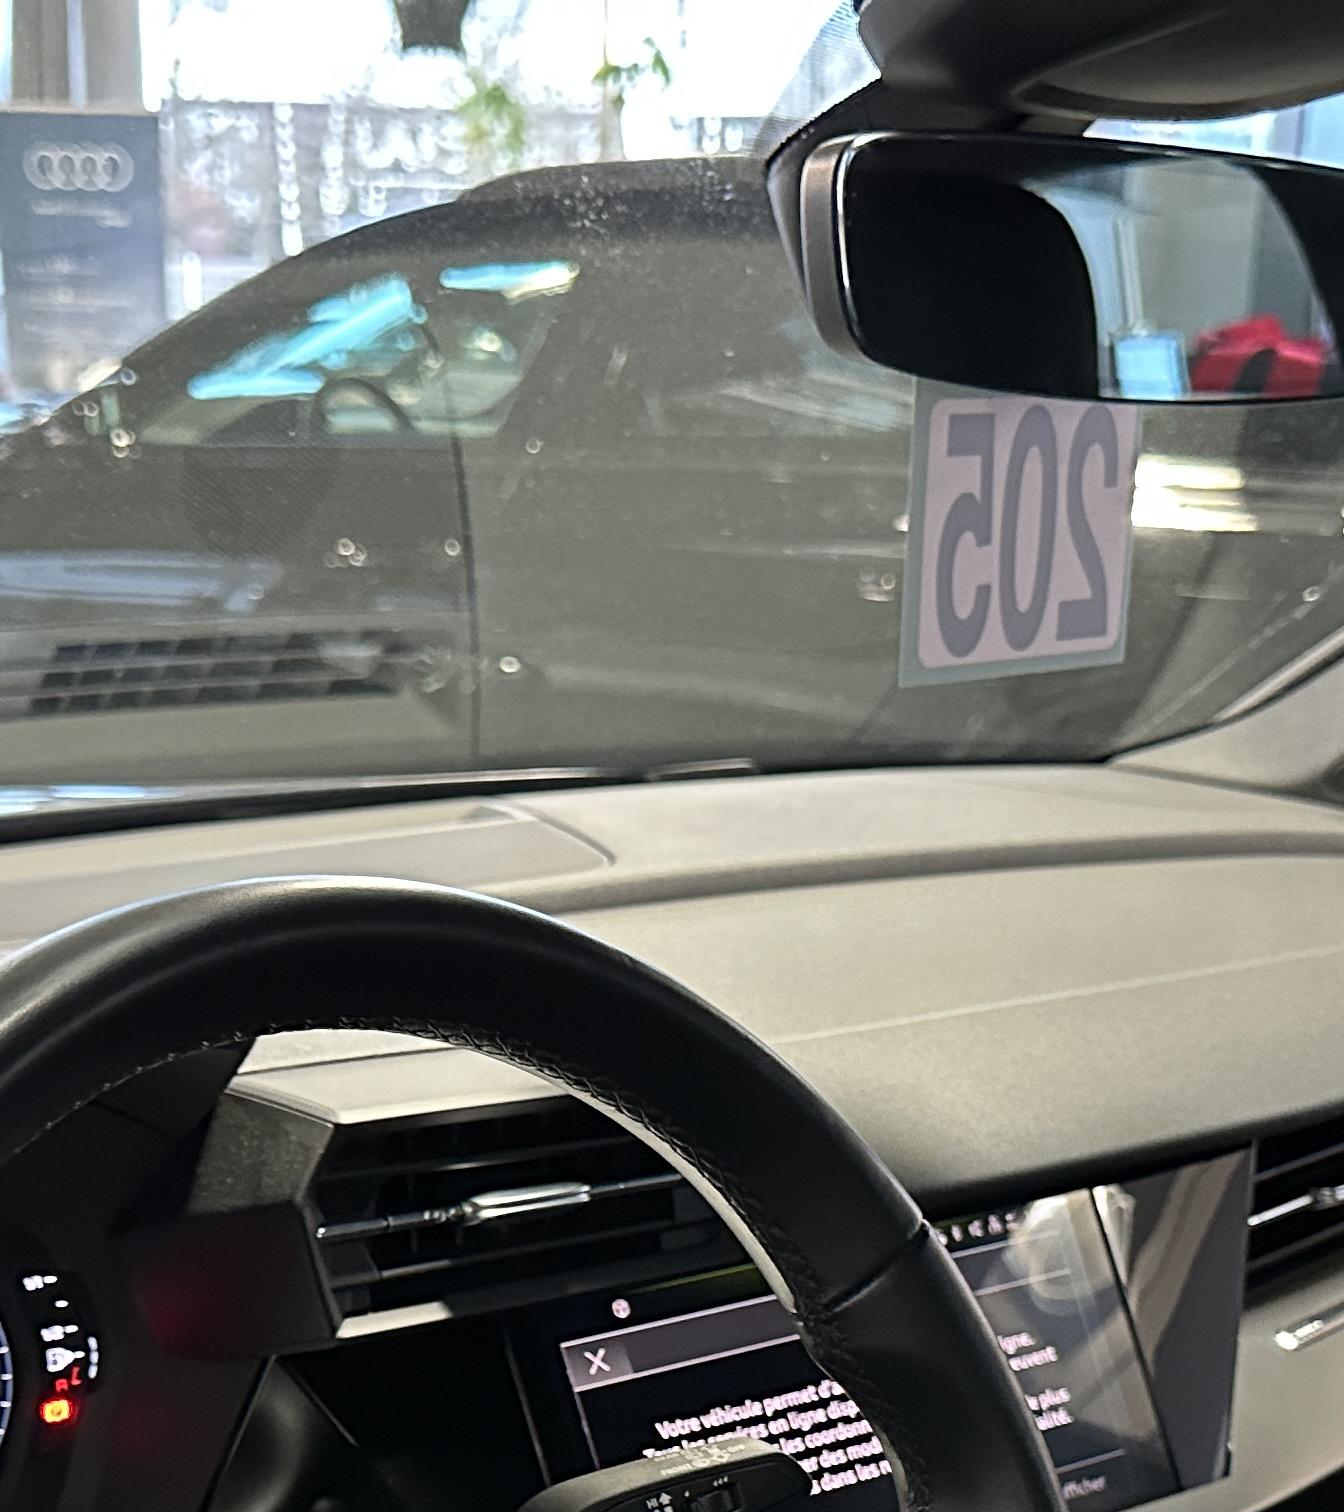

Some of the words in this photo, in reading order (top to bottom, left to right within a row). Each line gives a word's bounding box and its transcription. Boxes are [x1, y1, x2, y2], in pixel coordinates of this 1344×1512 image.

[655, 1417, 701, 1439] Votre
[763, 1385, 819, 1416] permet
[787, 1409, 827, 1431] ligne
[820, 1469, 857, 1491] dans
